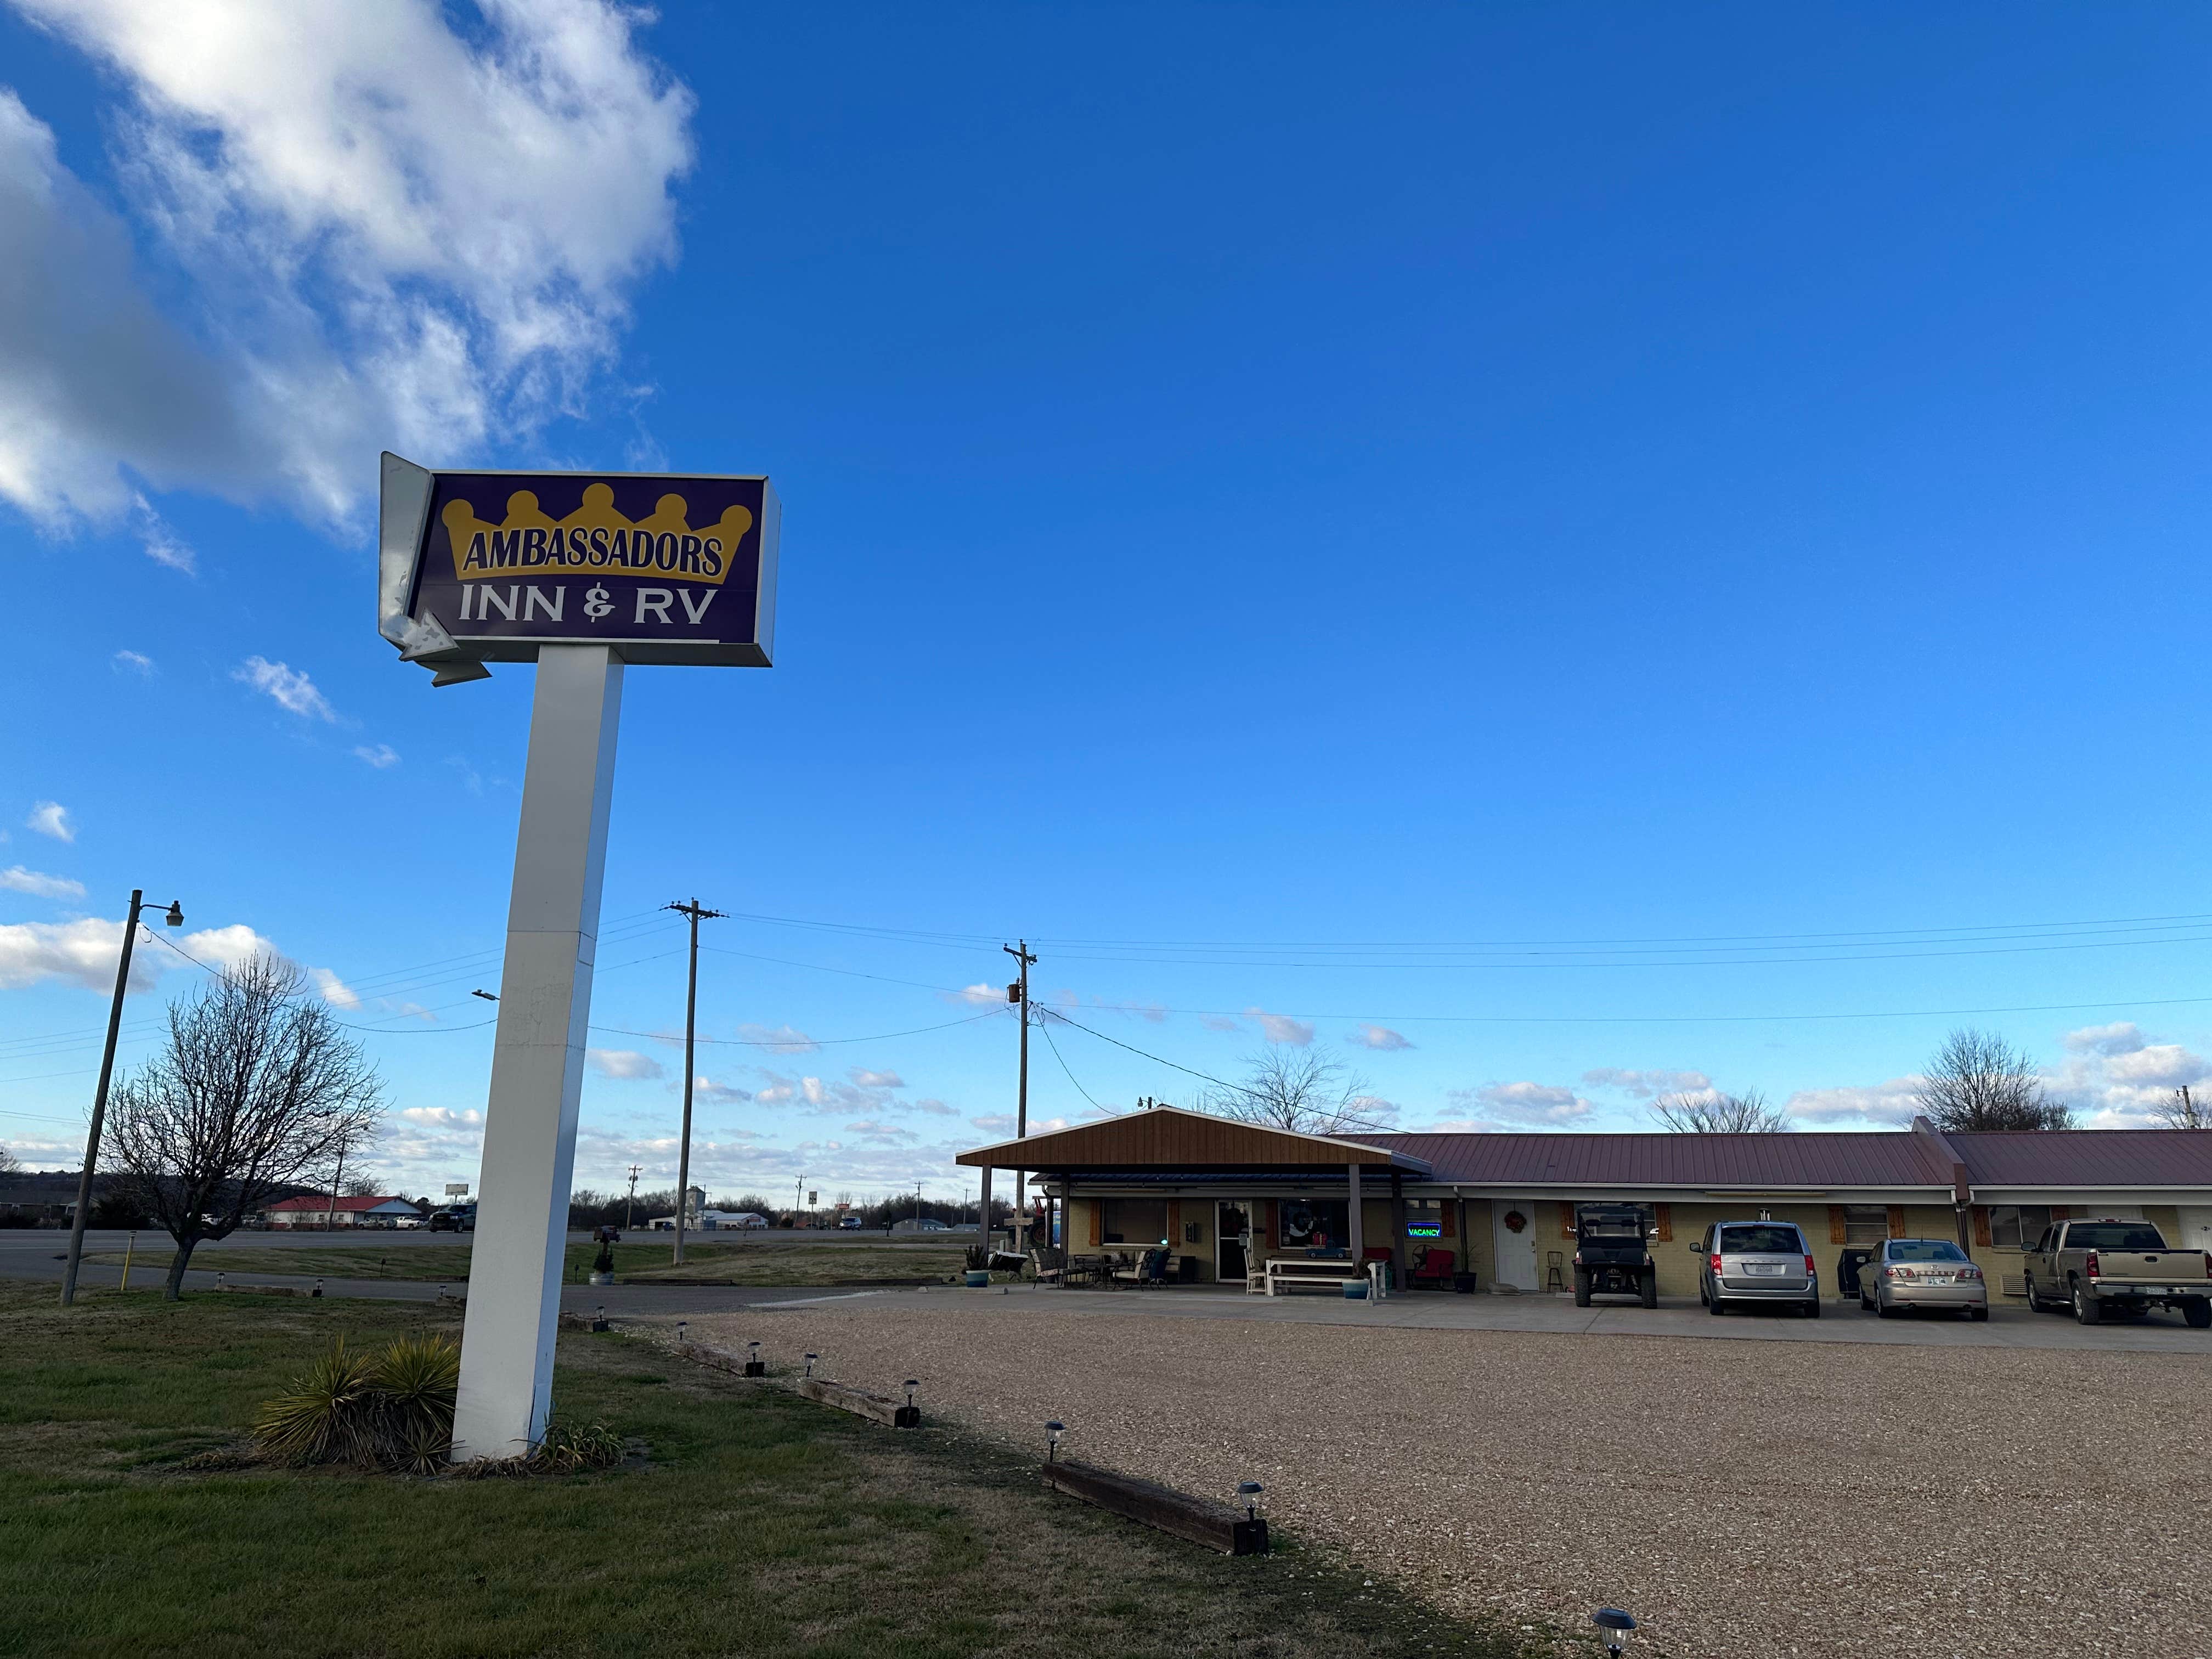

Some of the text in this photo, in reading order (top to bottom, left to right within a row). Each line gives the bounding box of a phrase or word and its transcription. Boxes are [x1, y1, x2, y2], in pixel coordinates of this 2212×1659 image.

[462, 527, 723, 577] AMBASSADORS
[458, 582, 718, 624] INN & RV
